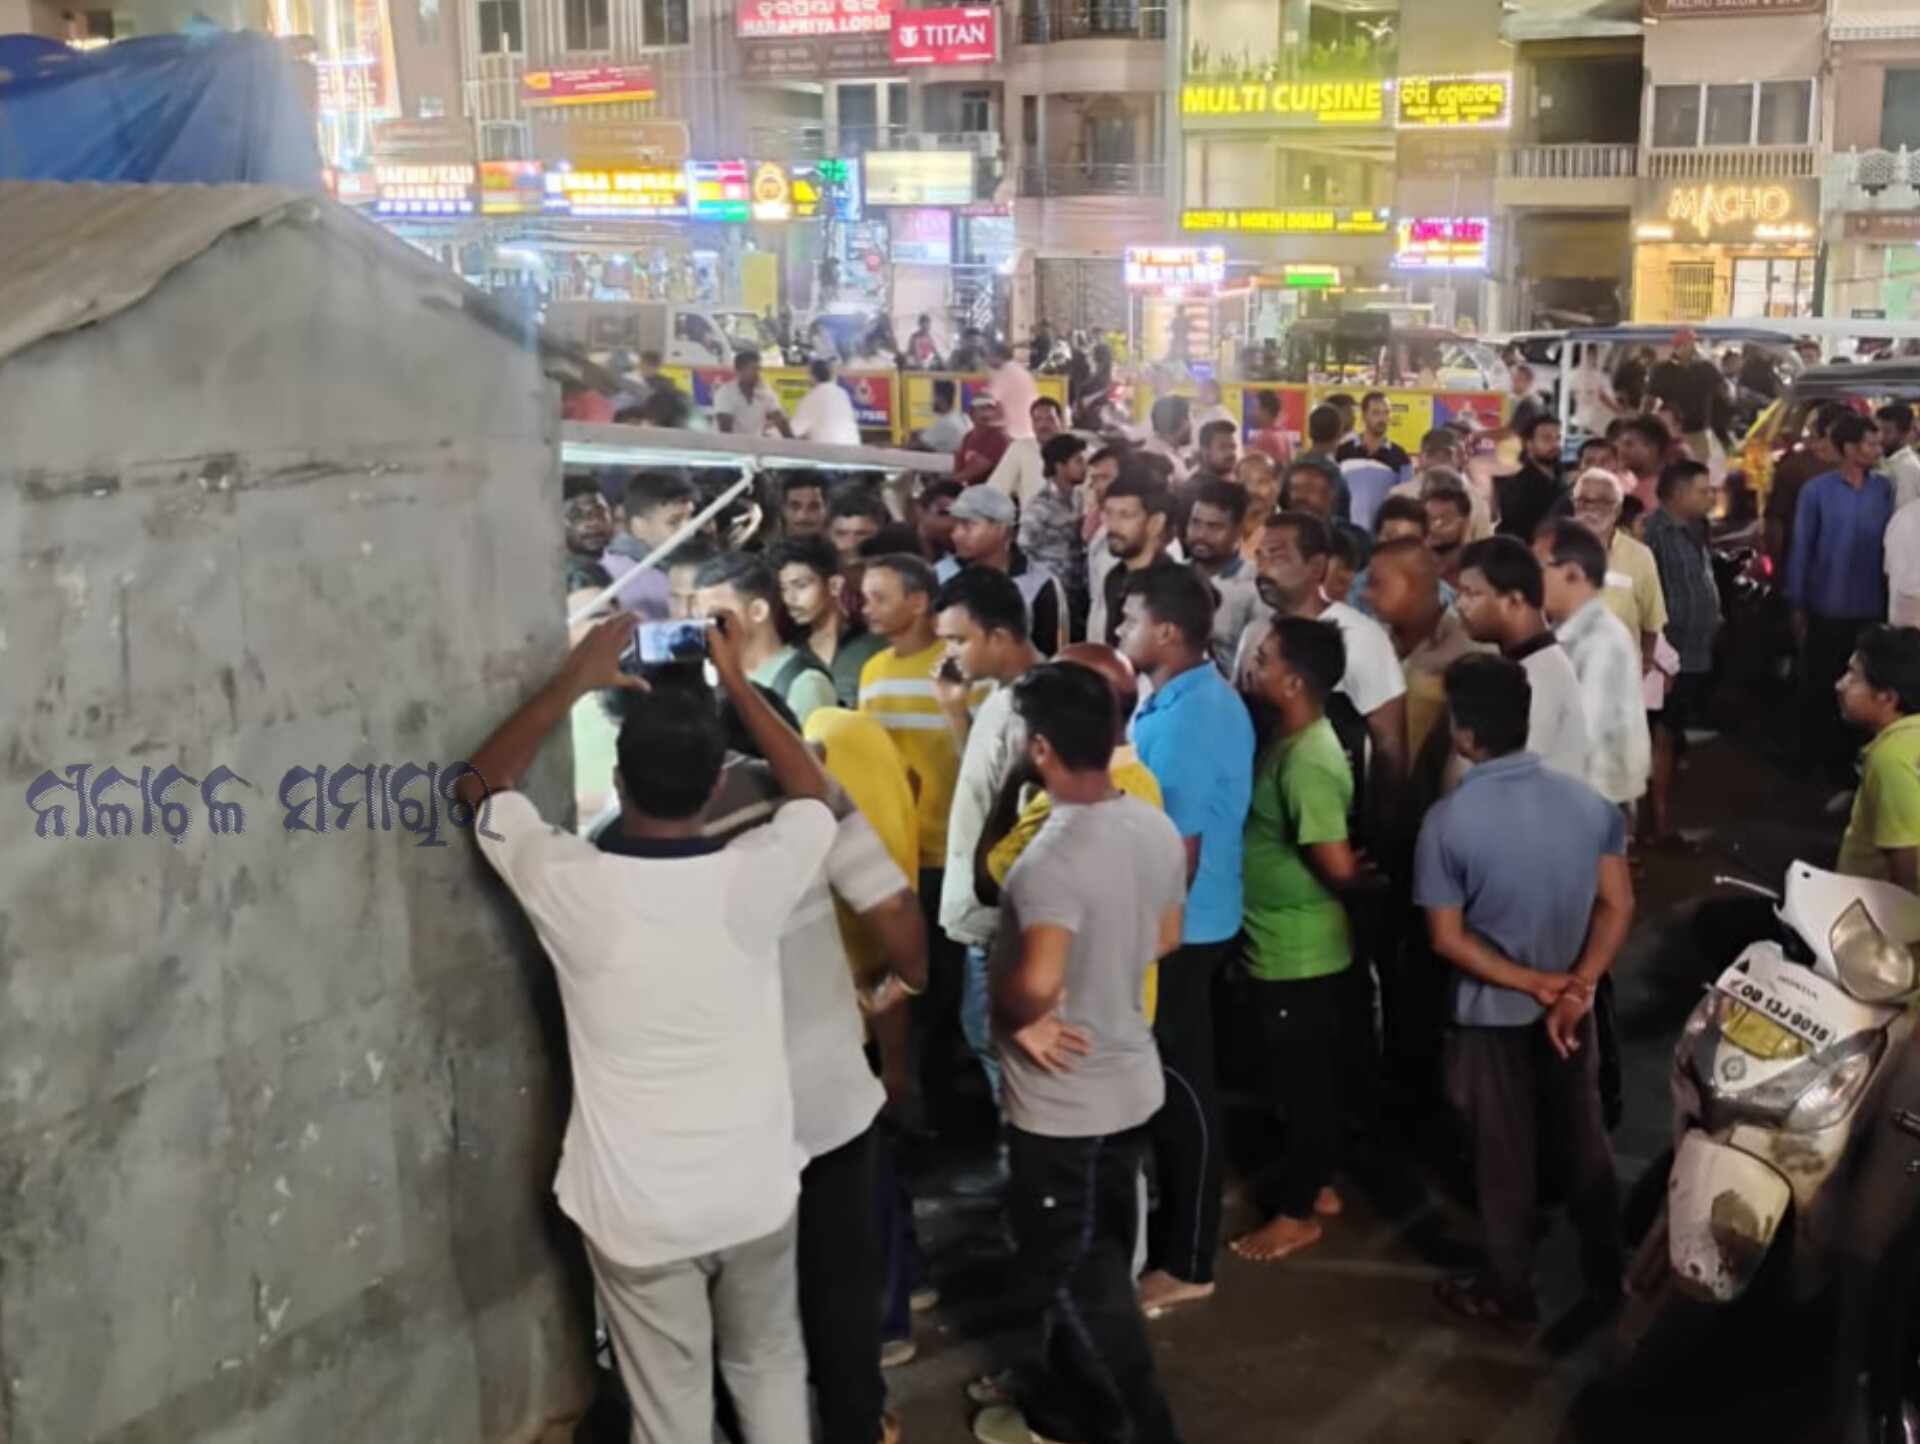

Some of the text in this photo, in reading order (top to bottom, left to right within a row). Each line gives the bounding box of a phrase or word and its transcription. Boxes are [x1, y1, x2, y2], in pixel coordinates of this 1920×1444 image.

[923, 24, 986, 47] TITAN
[1182, 84, 1265, 113] MULTI
[1272, 81, 1382, 111] CUISINE
[1667, 184, 1790, 229] MACHO
